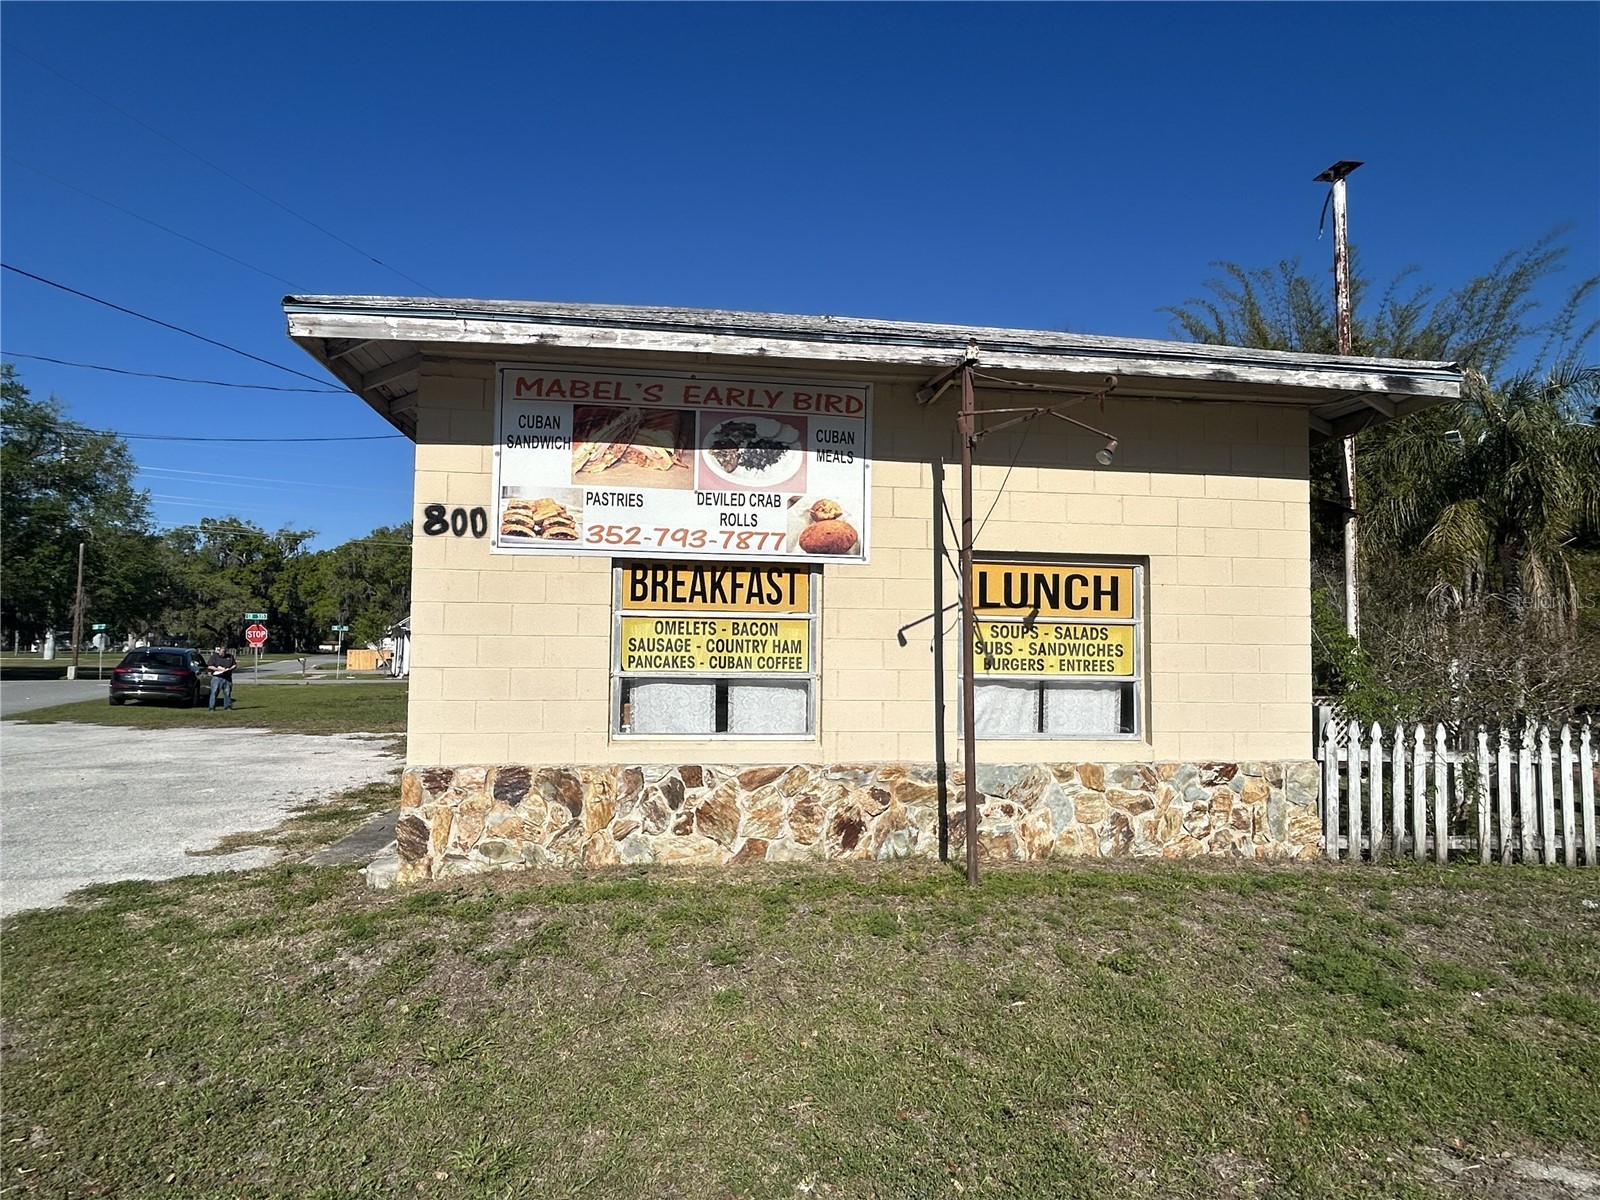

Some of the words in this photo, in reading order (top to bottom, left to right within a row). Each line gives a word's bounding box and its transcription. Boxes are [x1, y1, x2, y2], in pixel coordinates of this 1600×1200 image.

[516, 377, 664, 402] MABEL'S
[683, 386, 783, 410] EARLY
[793, 392, 864, 415] BIRD
[518, 415, 561, 431] CUBAN
[507, 434, 572, 451] SANDWICH
[816, 429, 855, 445] CUBAN
[816, 449, 854, 465] MEALS
[586, 492, 644, 508] PASTRIES
[697, 492, 746, 508] DEVILED
[749, 493, 782, 508] CRAB
[423, 505, 488, 539] 800
[720, 512, 758, 528] ROLLS
[585, 525, 787, 552] 352-793-7877
[630, 563, 800, 606] BREAKFAST
[978, 571, 1119, 612] LUNCH
[247, 630, 266, 639] STOP
[654, 620, 717, 636] OMELETS
[732, 622, 778, 637] BACON
[990, 625, 1039, 640] SOUPS
[1054, 626, 1108, 641] SALADS
[628, 638, 691, 653] SAUSAGE
[706, 639, 768, 654] COUNTRY
[772, 640, 802, 654] HAM
[974, 641, 1013, 655] SUBS
[1028, 643, 1124, 658] SANDWICHES
[628, 655, 695, 669] PANCAKES
[709, 656, 751, 670] CUBAN
[757, 656, 802, 670] COFFEE
[983, 658, 1045, 671] BURGERS
[1059, 659, 1115, 673] ENTREES
